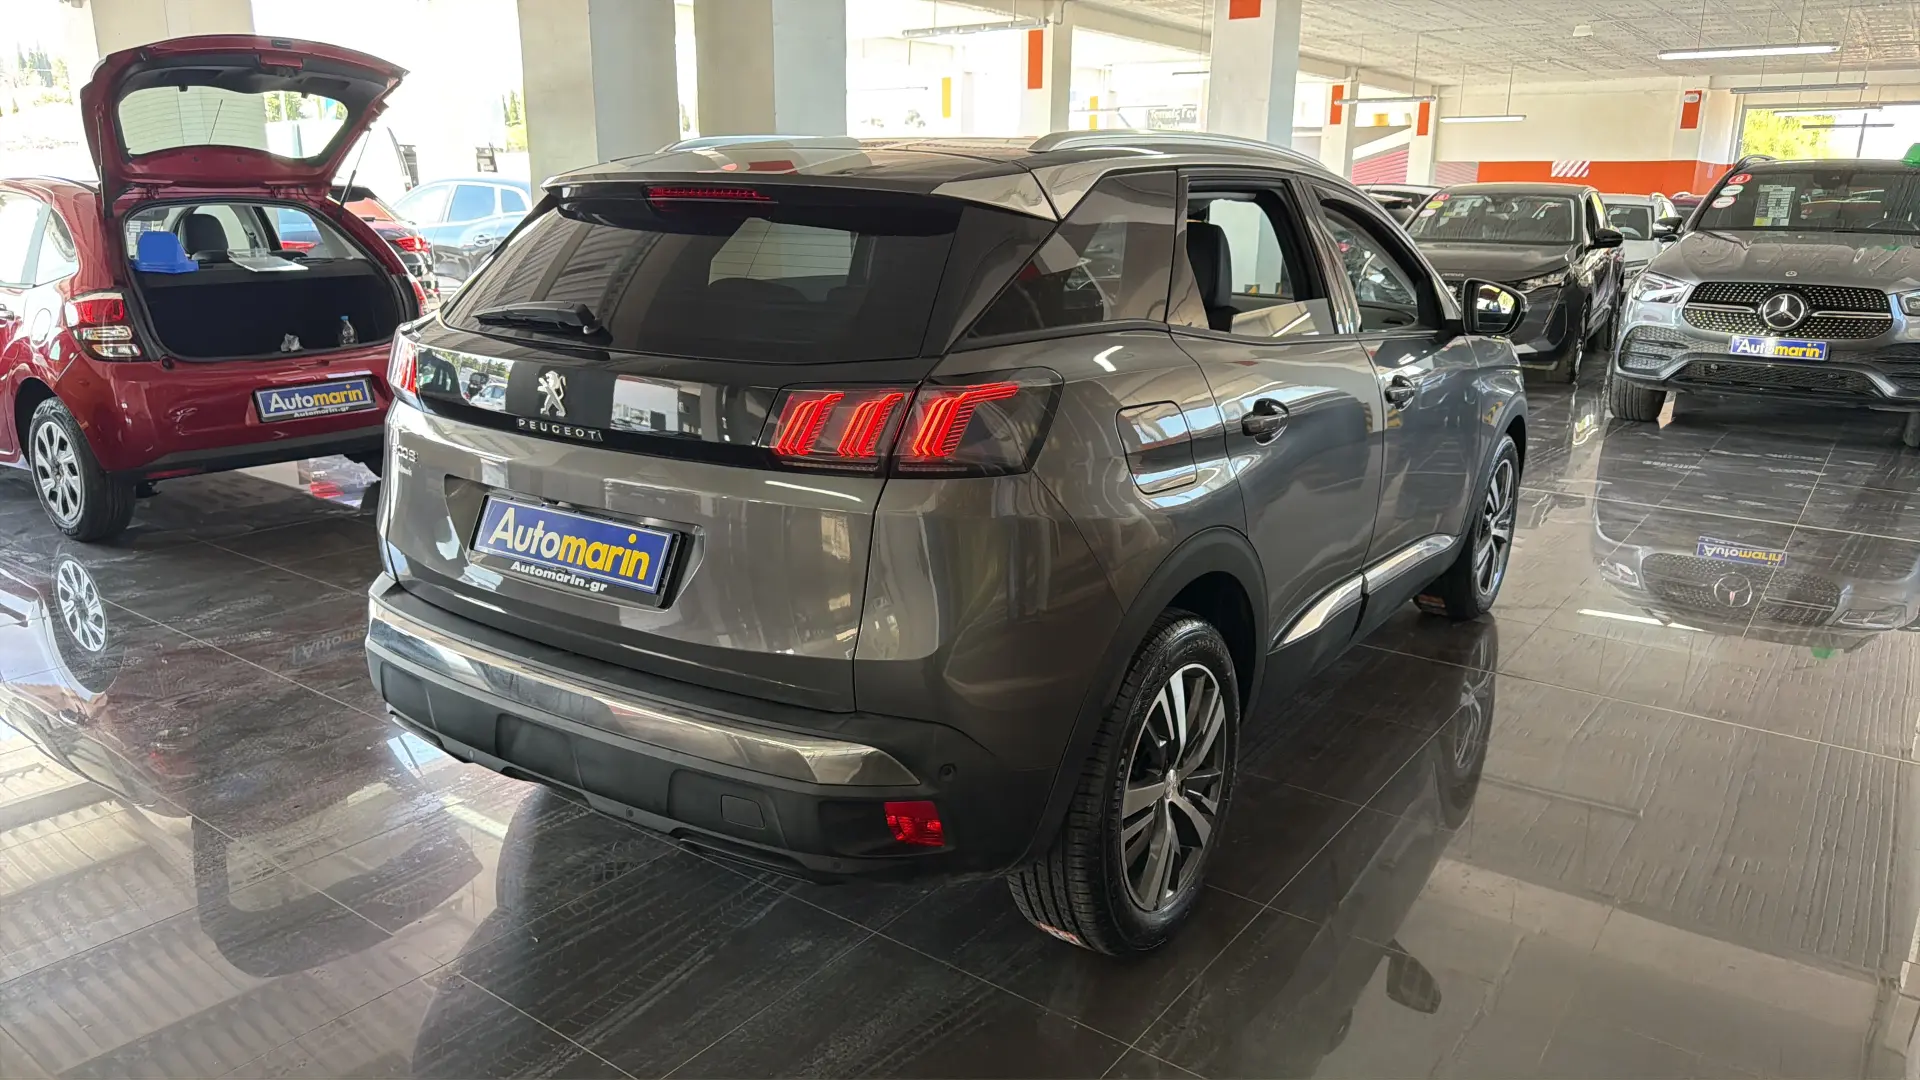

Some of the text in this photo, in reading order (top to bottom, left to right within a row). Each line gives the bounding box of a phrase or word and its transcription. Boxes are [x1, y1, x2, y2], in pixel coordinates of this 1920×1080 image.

[1737, 339, 1820, 358] Automarin
[270, 384, 363, 412] Automarin
[294, 406, 349, 418] Automarin.gr
[518, 419, 596, 440] PEUGEOT
[488, 507, 650, 580] Automarin
[511, 561, 608, 592] Automarin.gr
